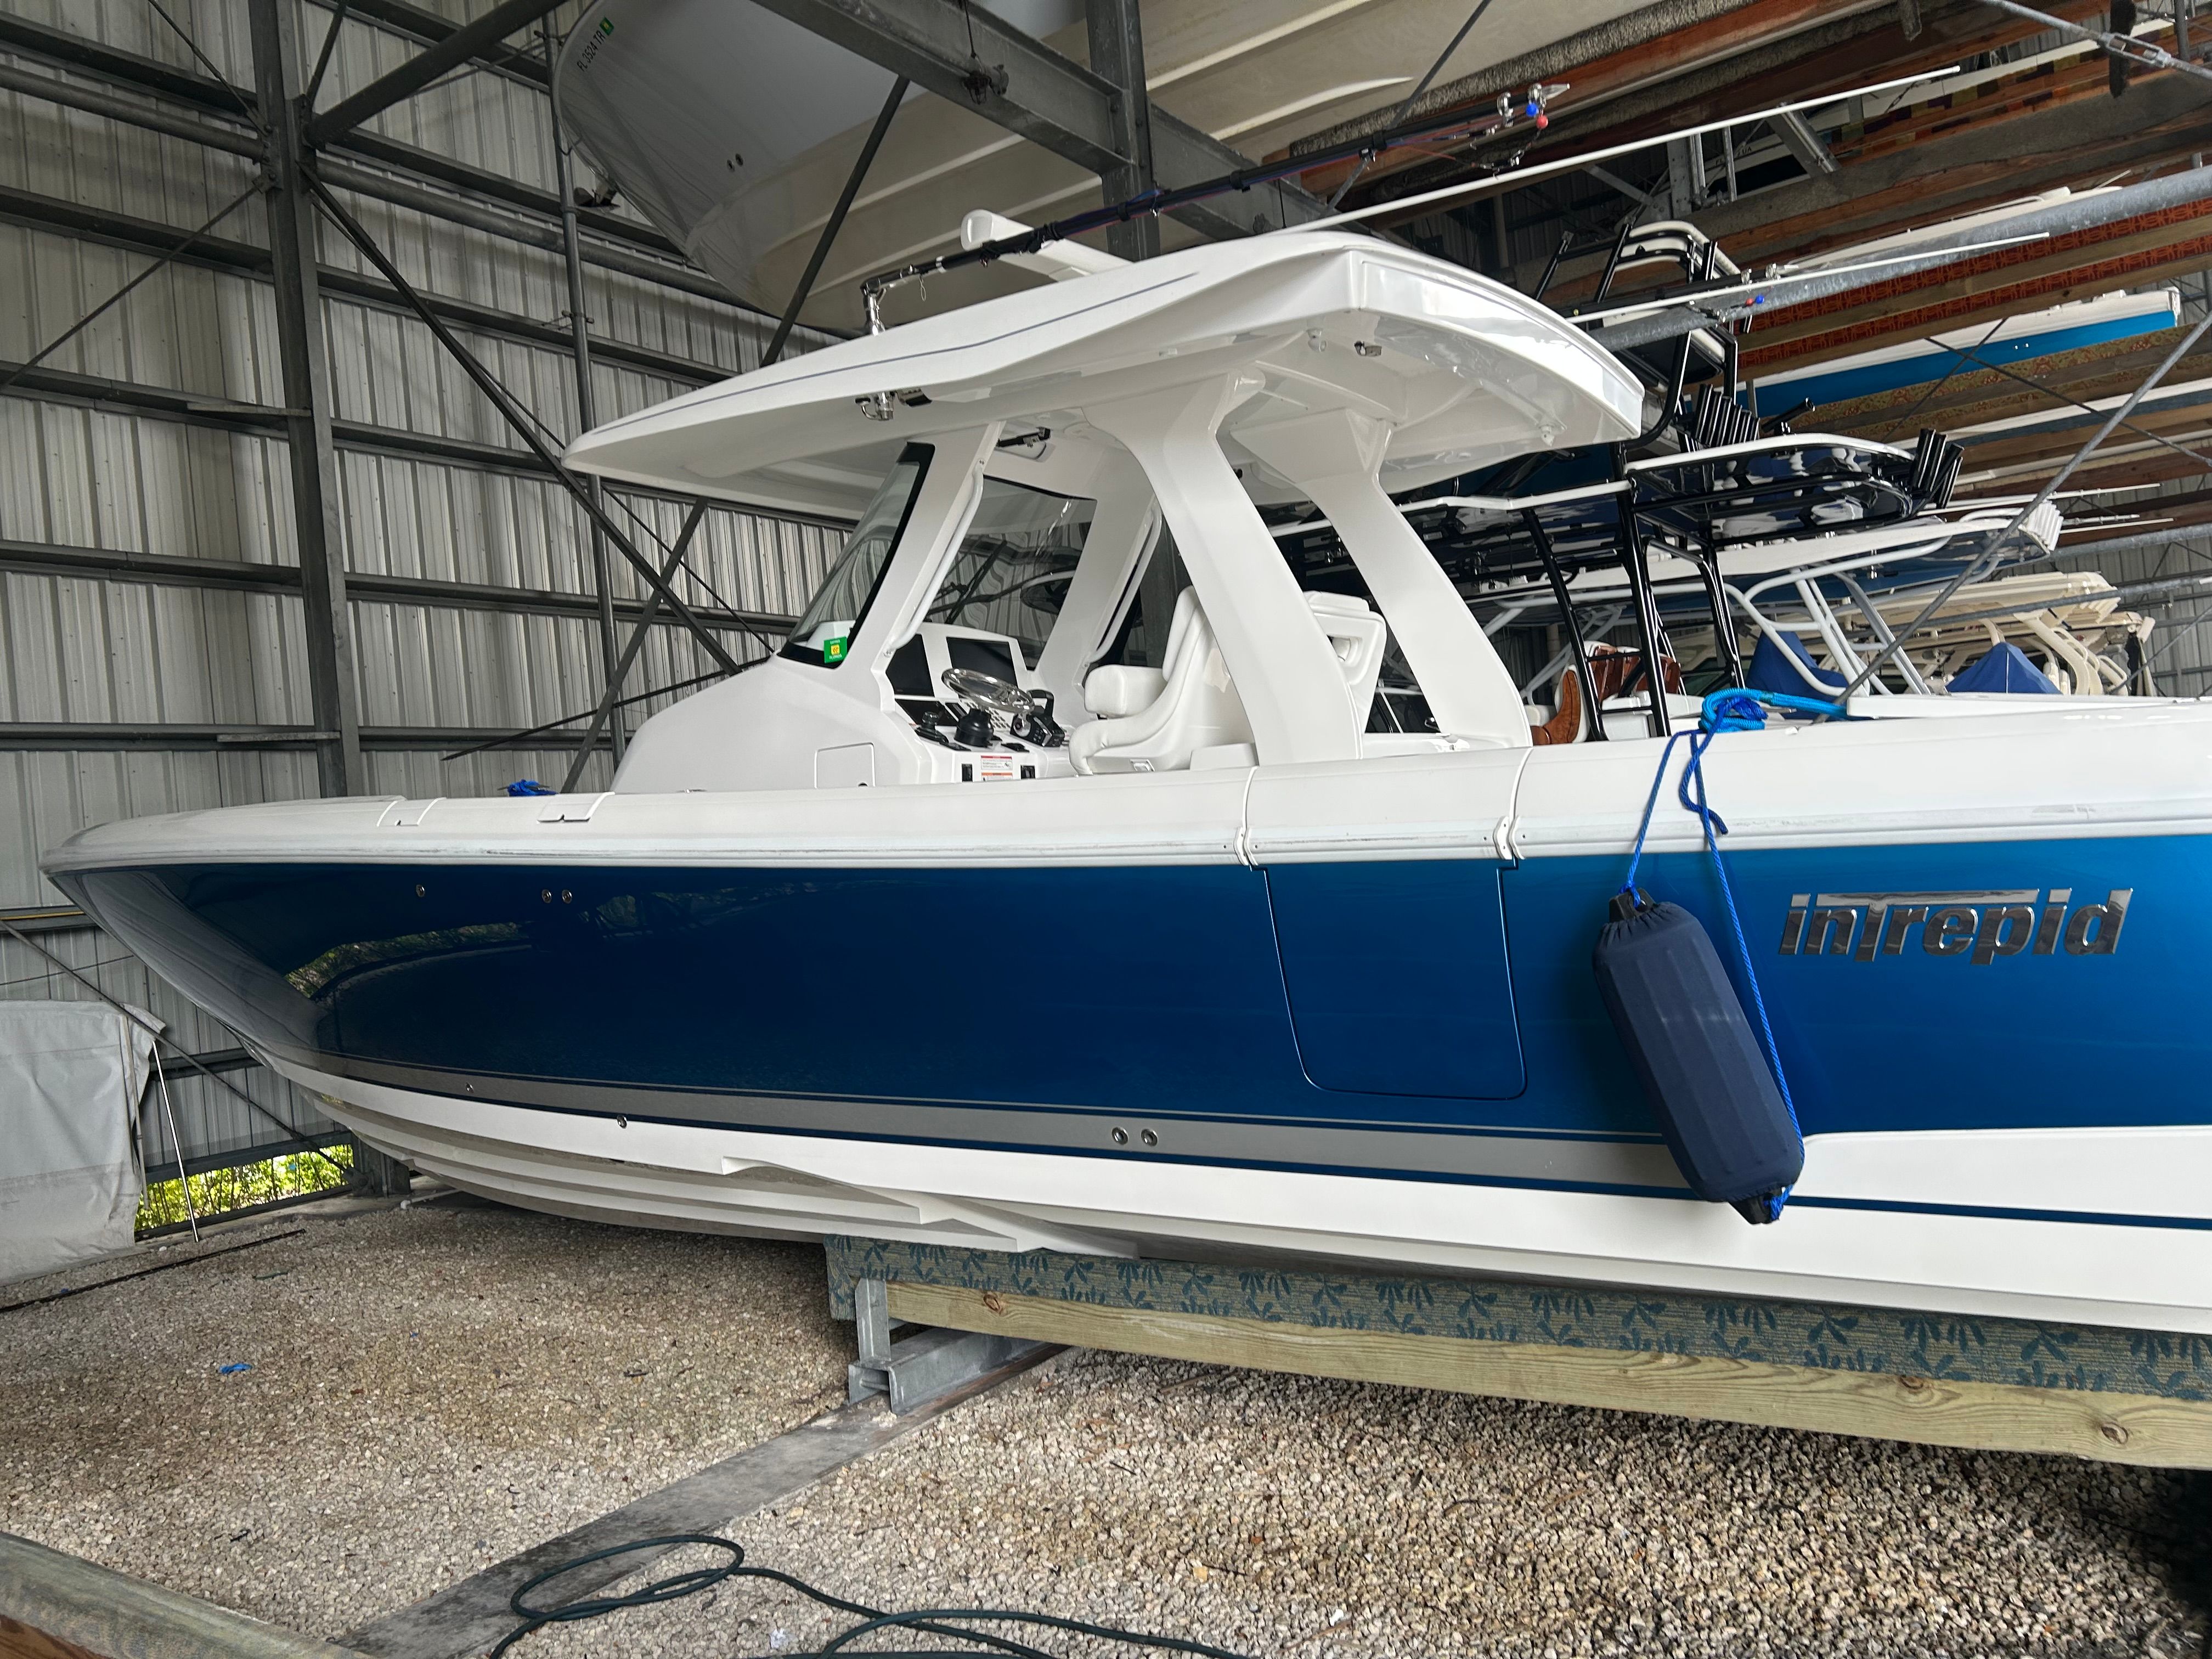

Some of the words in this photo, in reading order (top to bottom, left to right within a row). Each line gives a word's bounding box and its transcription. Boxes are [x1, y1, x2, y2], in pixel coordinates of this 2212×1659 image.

[593, 30, 606, 45] TR
[582, 41, 598, 63] 3524
[577, 60, 588, 72] FL
